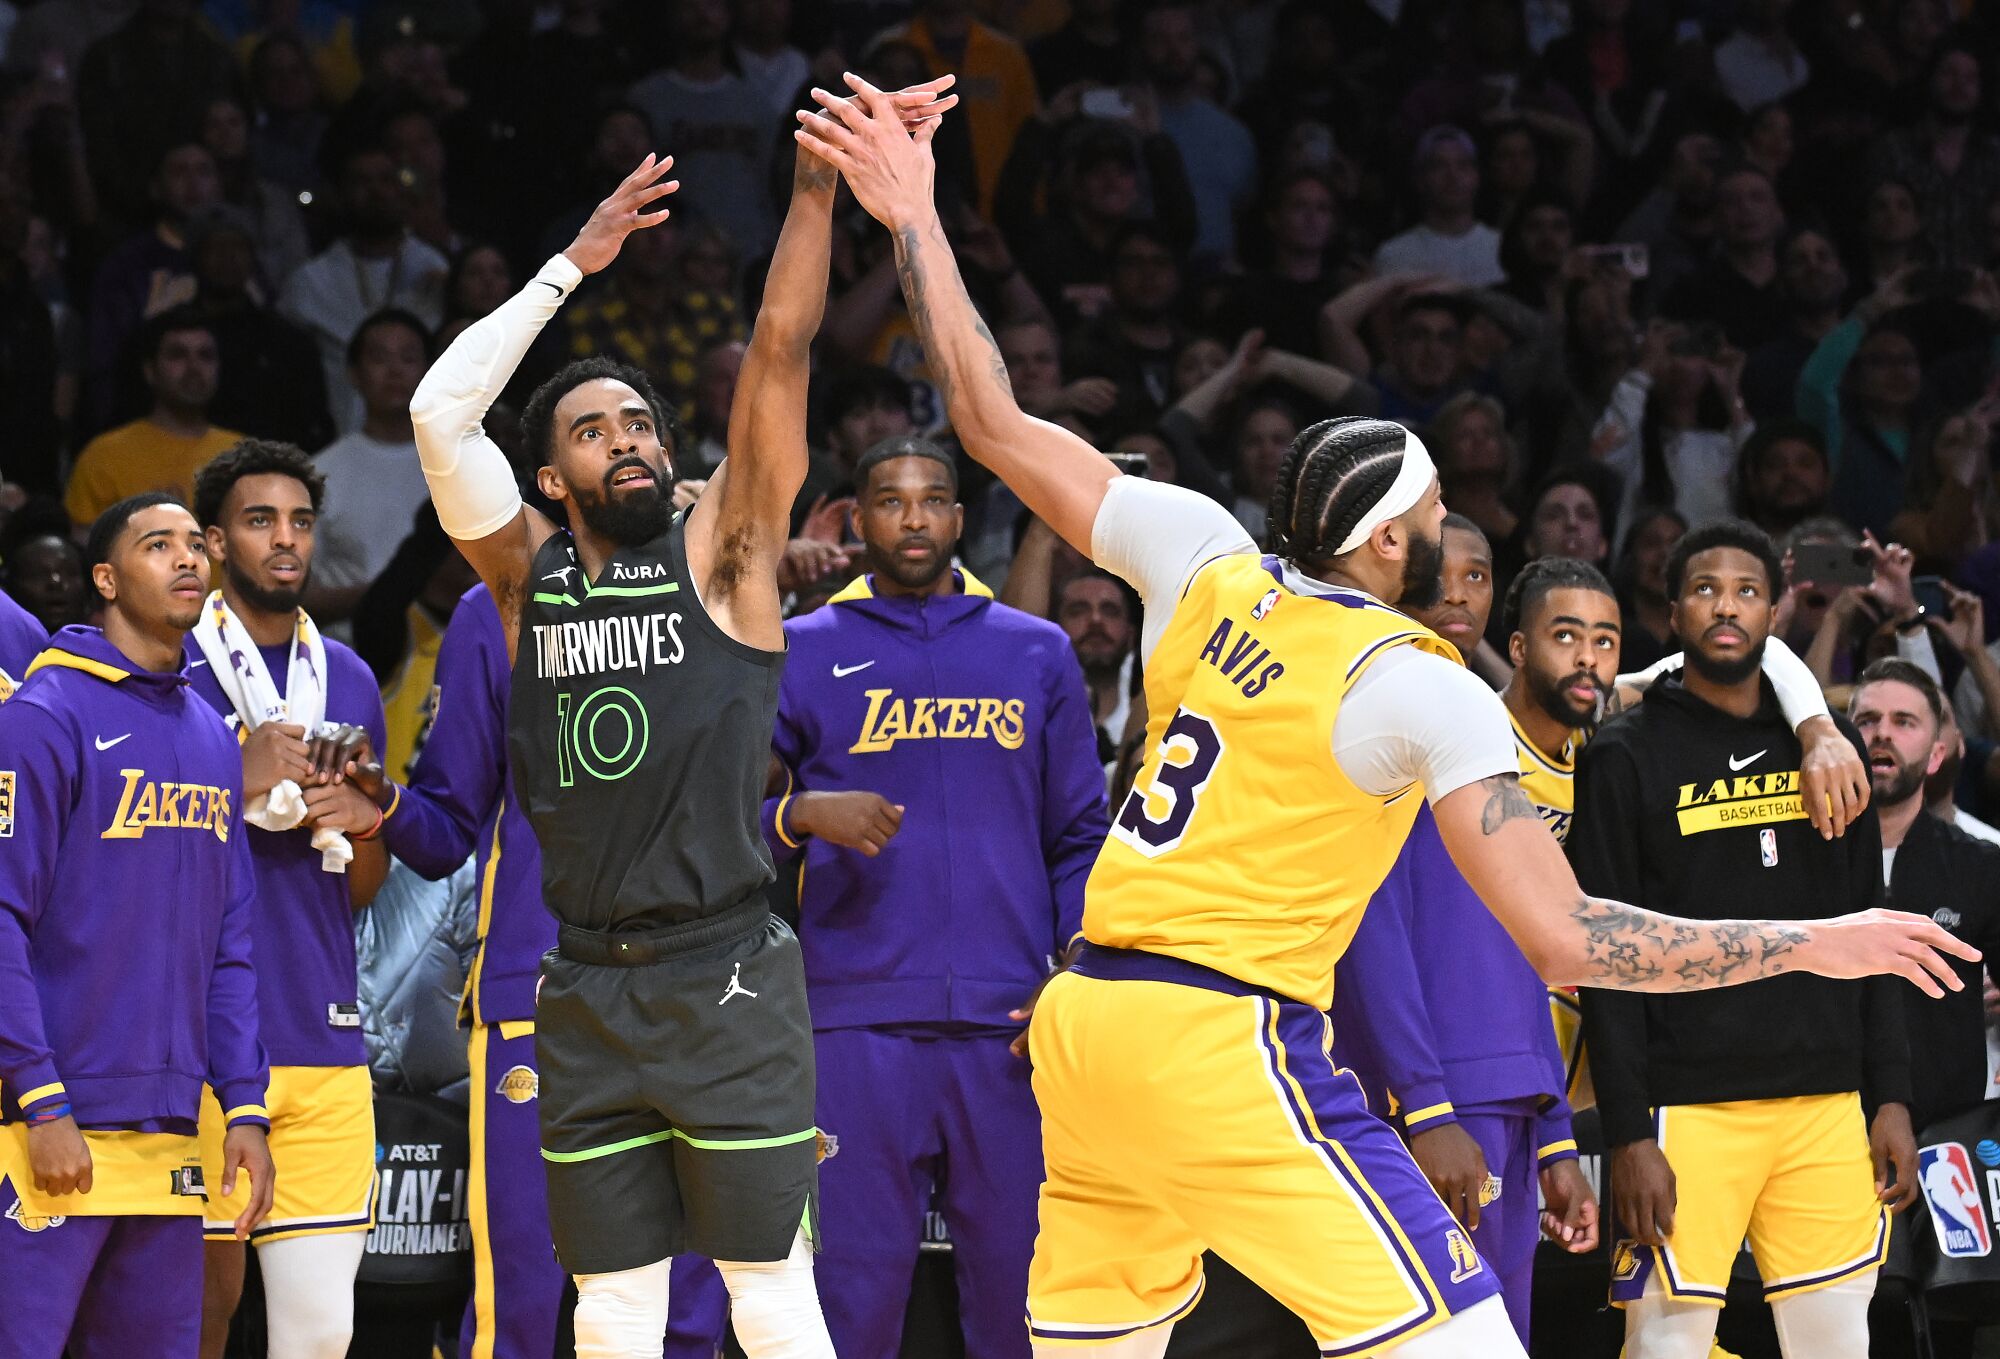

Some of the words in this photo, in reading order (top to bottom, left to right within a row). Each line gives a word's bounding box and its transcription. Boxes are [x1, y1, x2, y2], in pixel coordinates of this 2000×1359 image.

[1200, 616, 1285, 699] AVIS
[558, 686, 649, 788] 10
[848, 688, 1026, 754] LAKERS
[101, 768, 231, 843] LAKERS
[1112, 705, 1224, 857] 3
[1676, 771, 1801, 809] LAKE
[388, 1144, 442, 1162] AT&T
[378, 1169, 470, 1223] LAY-I
[366, 1224, 471, 1255] OURNAMEN
[1945, 1229, 1975, 1251] NBA
